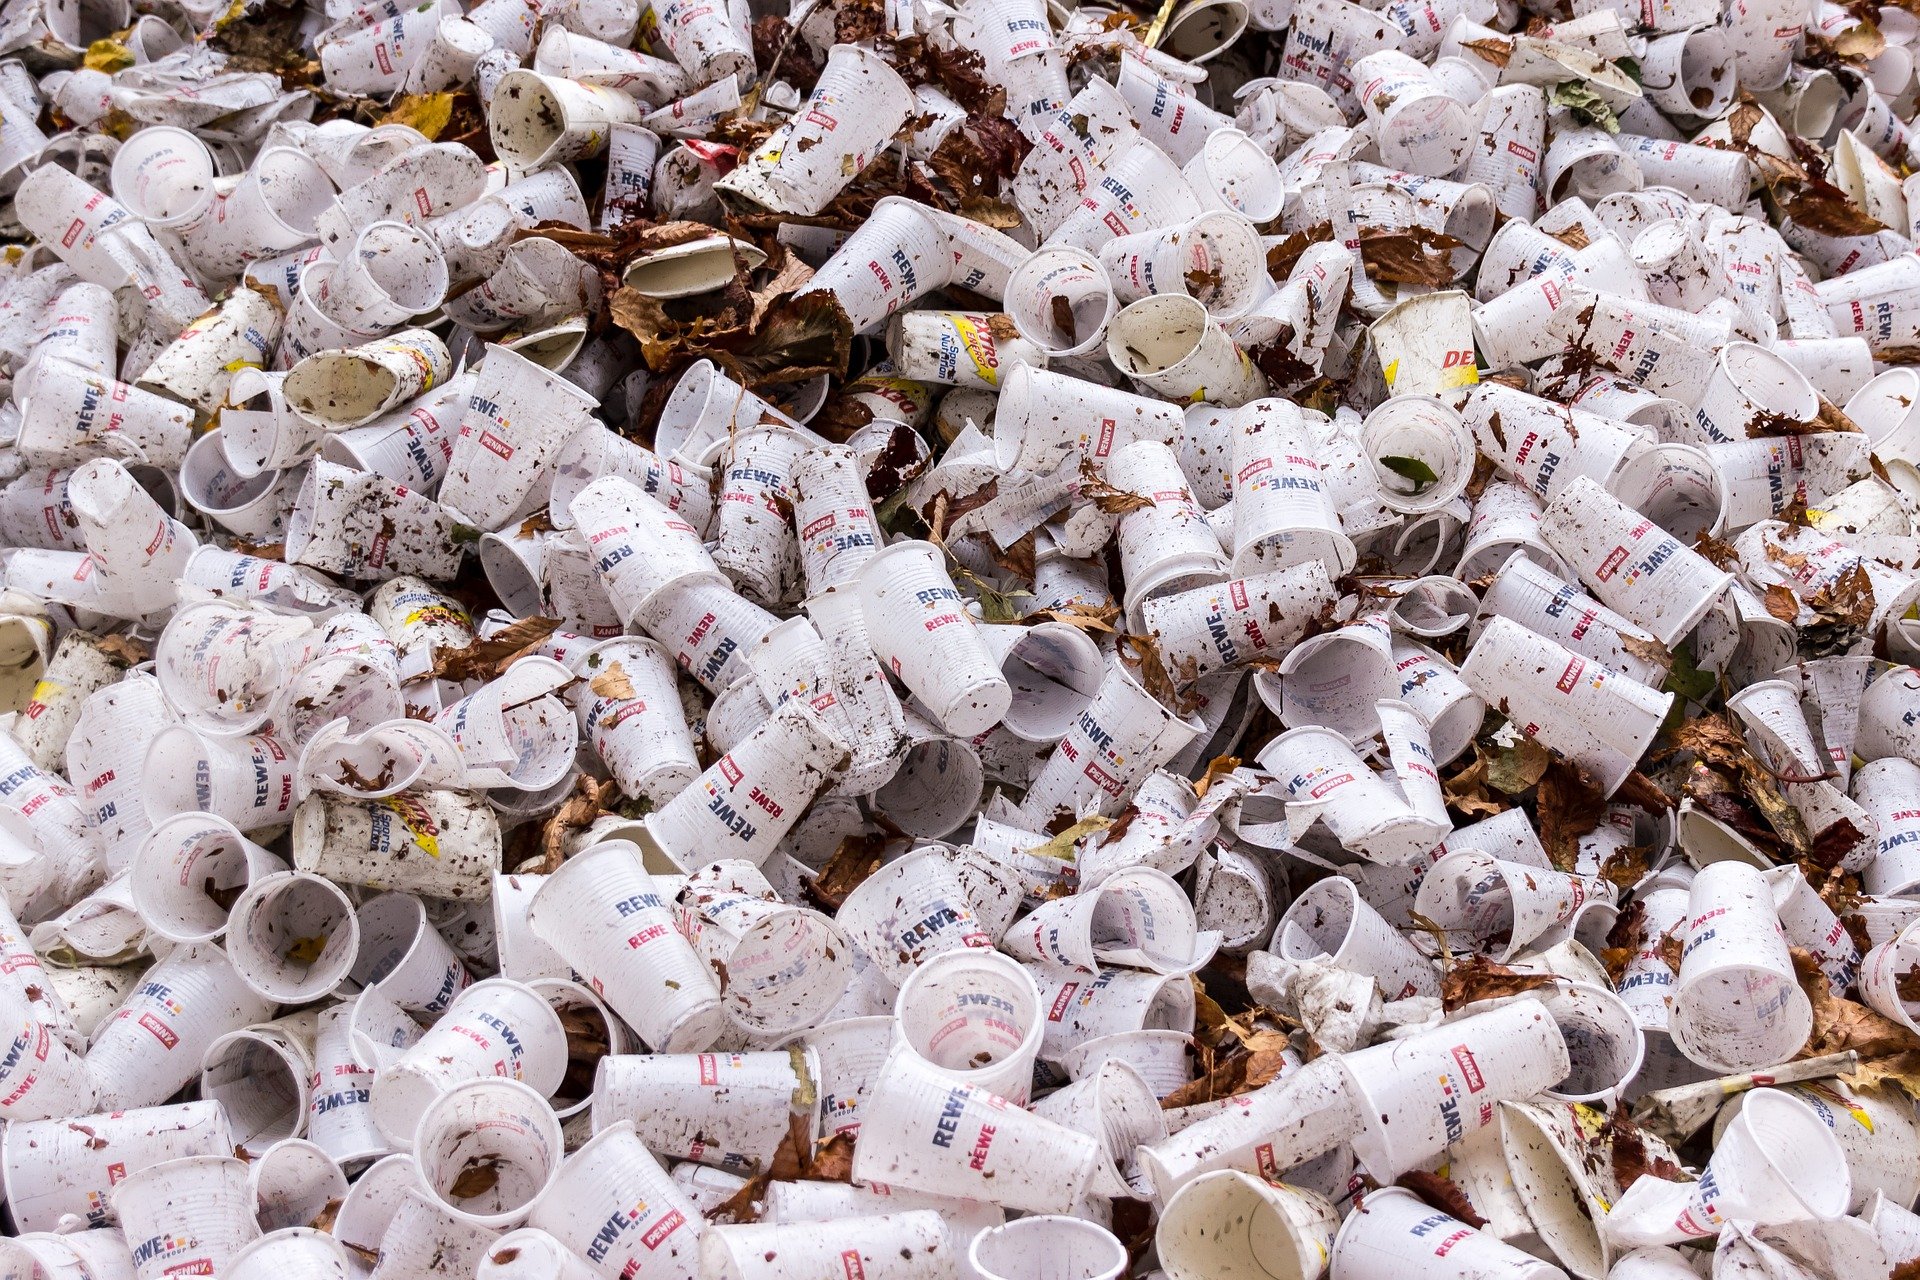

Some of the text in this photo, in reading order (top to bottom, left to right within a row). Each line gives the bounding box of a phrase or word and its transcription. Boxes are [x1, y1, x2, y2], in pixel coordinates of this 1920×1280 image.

[1010, 40, 1040, 54] REWE
[1152, 78, 1167, 118] REWE
[1171, 104, 1186, 135] REWE
[1103, 176, 1133, 205] REWE
[868, 261, 893, 293] REWE
[1130, 255, 1138, 288] REWE
[1836, 253, 1859, 276] REWE
[1851, 301, 1864, 332] REWE
[1613, 330, 1634, 360] REWE
[77, 387, 99, 432] REWE
[480, 432, 513, 460] PENNY.
[1097, 420, 1114, 456] PENNY.
[1515, 432, 1538, 466] REWE
[408, 439, 434, 481] REWE
[1239, 459, 1271, 482] PENNY.
[1285, 455, 1318, 469] REWE
[1535, 452, 1560, 494] REWE
[731, 469, 780, 487] REWE
[1270, 477, 1320, 493] REWE
[1769, 462, 1782, 514] REWE
[723, 492, 755, 505] REWE
[591, 526, 628, 544] REWE
[1597, 546, 1629, 582] PENNY.
[1642, 538, 1680, 578] REWE
[688, 613, 716, 647] REWE
[925, 614, 963, 631] REWE
[1207, 610, 1238, 665] REWE
[1571, 607, 1597, 642] REWE
[711, 637, 736, 683] REWE
[1080, 711, 1113, 751] REWE
[254, 755, 269, 808] REWE
[278, 774, 291, 812] REWE
[1312, 775, 1354, 798] PENNY.
[709, 793, 756, 842] REWE
[750, 787, 784, 818] REWE
[380, 814, 392, 853] Sports
[628, 925, 668, 949] REWE
[903, 908, 953, 943] REWE
[427, 966, 456, 1012] REWE
[1618, 972, 1670, 991] REWE
[1050, 984, 1077, 1019] PENNY.
[140, 1014, 179, 1050] PENNY.
[452, 1025, 489, 1051] REWE
[479, 1012, 523, 1058] REWE
[1447, 1073, 1461, 1098] GROUP
[1452, 1045, 1484, 1092] PENNY.
[4, 1075, 37, 1107] REWE
[318, 1090, 370, 1114] REWE
[932, 1087, 969, 1148] REWE
[969, 1124, 997, 1171] REWE
[587, 1211, 630, 1262] REWE
[630, 1210, 653, 1230] GROUP
[642, 1211, 685, 1250] PENNY.
[162, 1247, 187, 1260] GROUP
